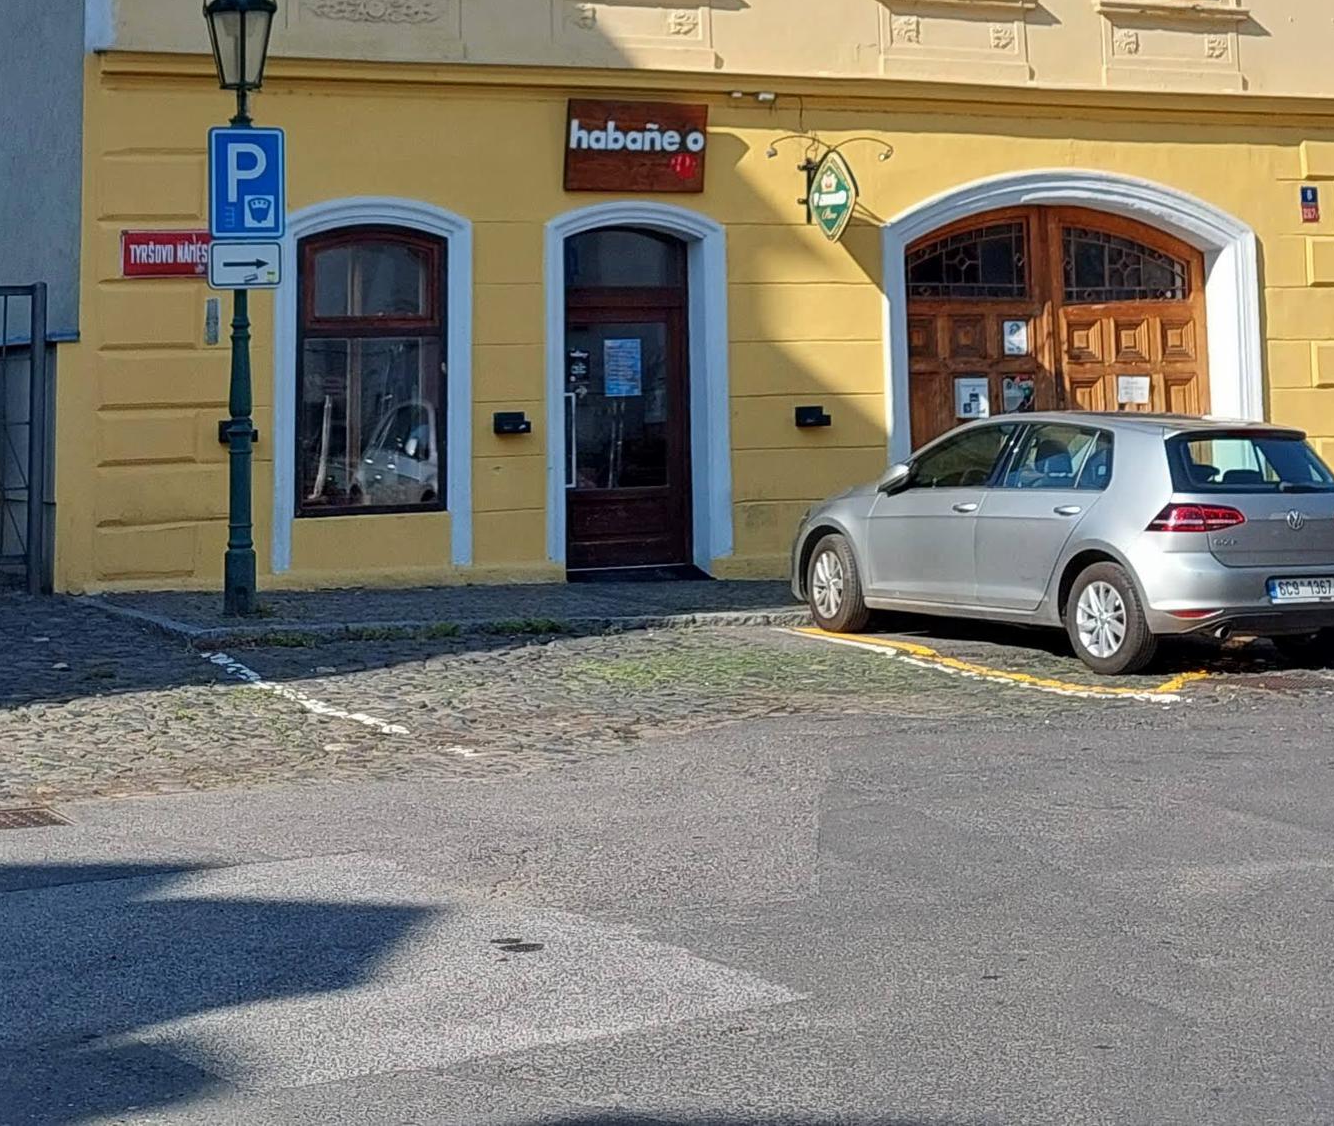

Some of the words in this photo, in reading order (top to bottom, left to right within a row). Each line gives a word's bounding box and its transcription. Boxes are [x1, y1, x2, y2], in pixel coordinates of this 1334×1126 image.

[570, 119, 704, 152] habañeo
[227, 142, 267, 203] P
[129, 241, 174, 264] TYRŠOVO
[1278, 579, 1300, 596] 6C9
[1308, 579, 1332, 595] 1367
